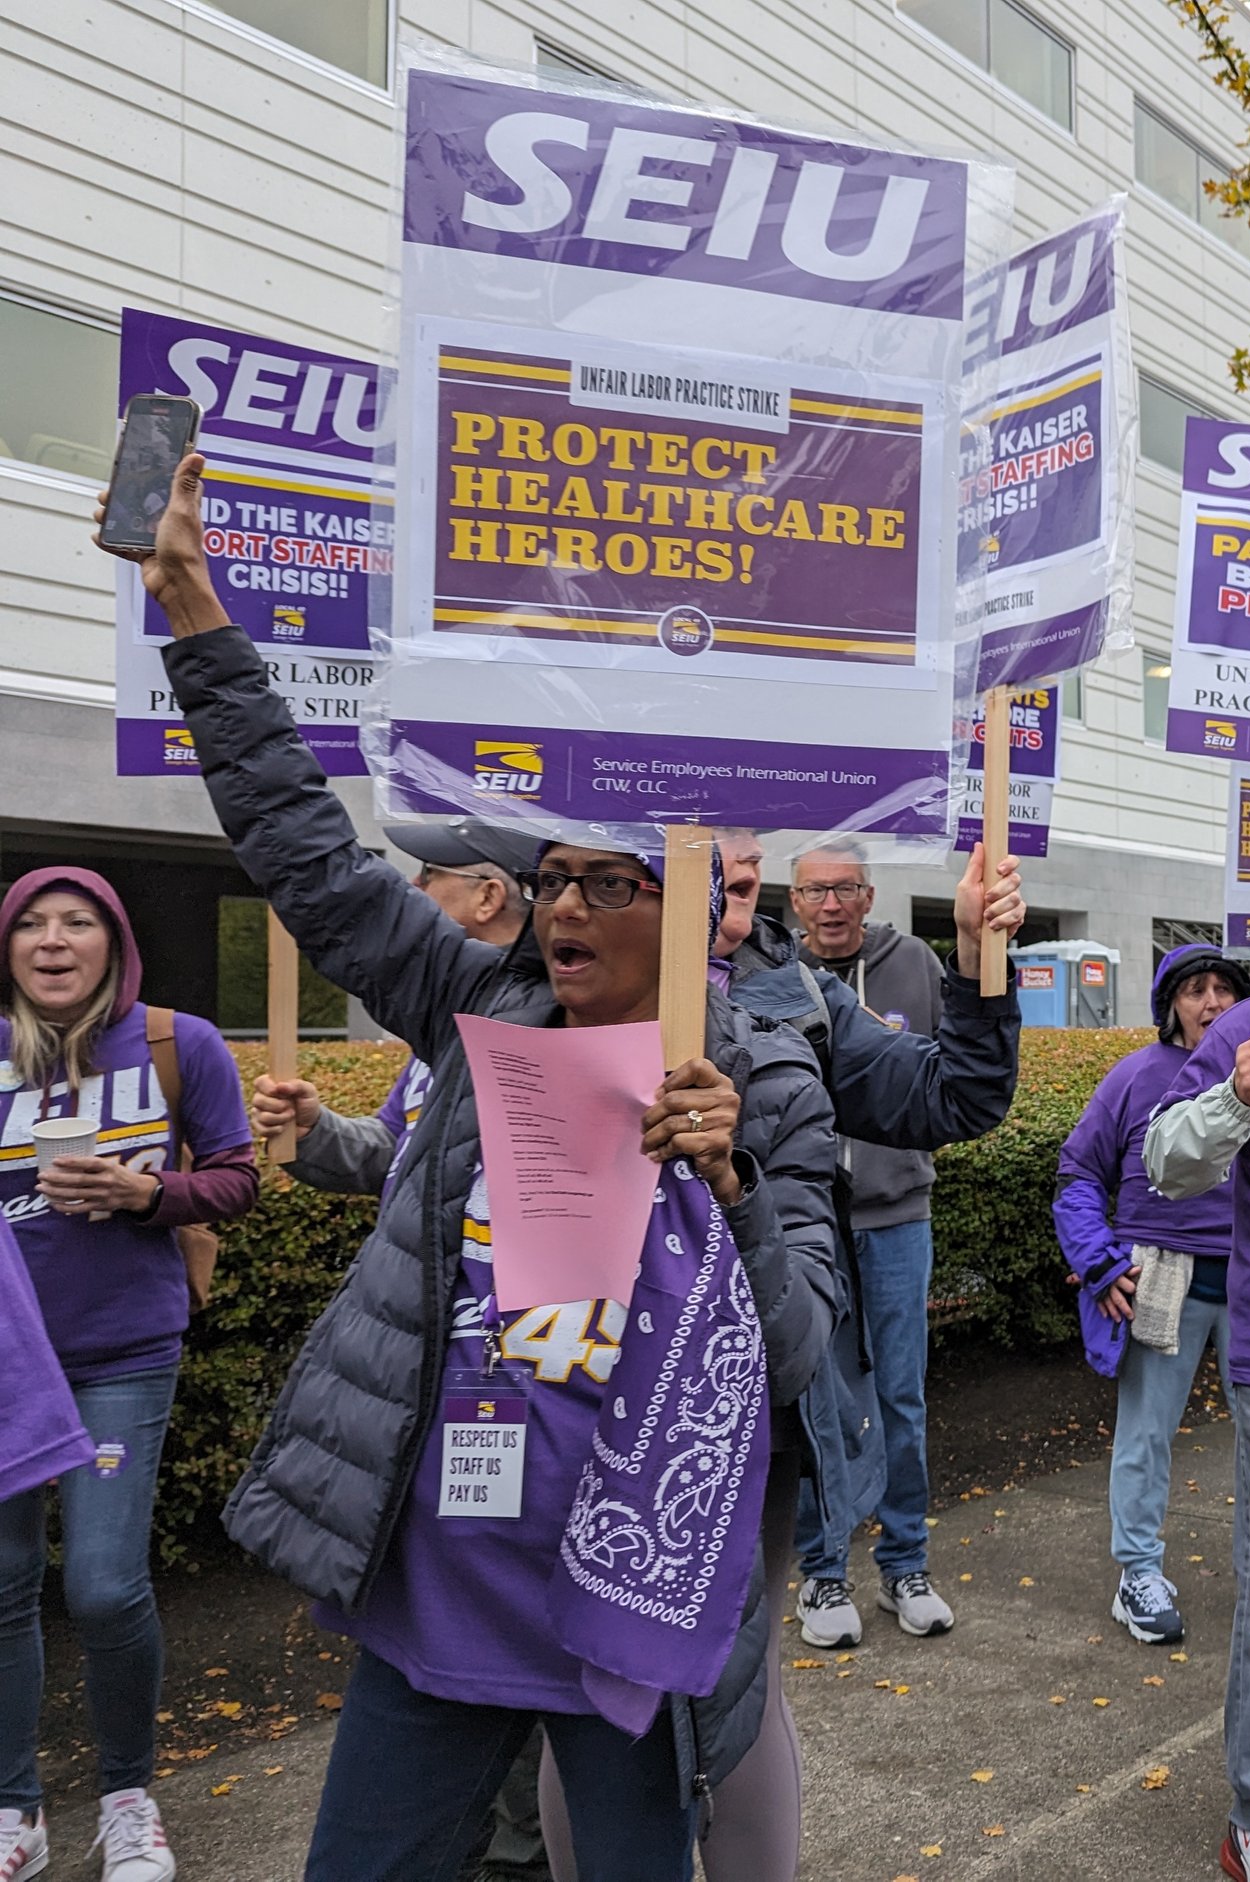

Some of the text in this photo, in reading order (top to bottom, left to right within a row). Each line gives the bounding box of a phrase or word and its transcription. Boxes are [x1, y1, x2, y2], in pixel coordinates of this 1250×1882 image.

[461, 111, 931, 282] SEIU
[962, 231, 1096, 360] EIU
[155, 338, 398, 448] SEIU
[580, 366, 780, 417] UNFAIR LABOR PRACTICE STRIKE
[999, 405, 1088, 457] KAISER
[451, 411, 776, 484] PROTECT
[977, 432, 1095, 498] STAFFING
[236, 502, 297, 533] THE
[449, 464, 906, 549] HEALTHCARE
[203, 528, 269, 561] ORT
[448, 518, 755, 584] HEROES!
[227, 564, 349, 599] CRISIS!!
[1011, 590, 1034, 610] STRIKE
[272, 625, 305, 637] SEIU
[1058, 626, 1081, 641] Union
[290, 663, 374, 686] LABOR
[304, 697, 361, 718] STRI
[1203, 734, 1237, 747] SEIU
[472, 772, 543, 792] SEIU
[592, 757, 877, 786] Service Employees International Union
[592, 777, 668, 794] CTW, CLC
[1008, 782, 1031, 798] BOR
[1010, 804, 1040, 820] RIKE
[451, 1430, 518, 1448] RESPECT US
[449, 1457, 502, 1475] STAFF US
[448, 1484, 488, 1503] PAY US
